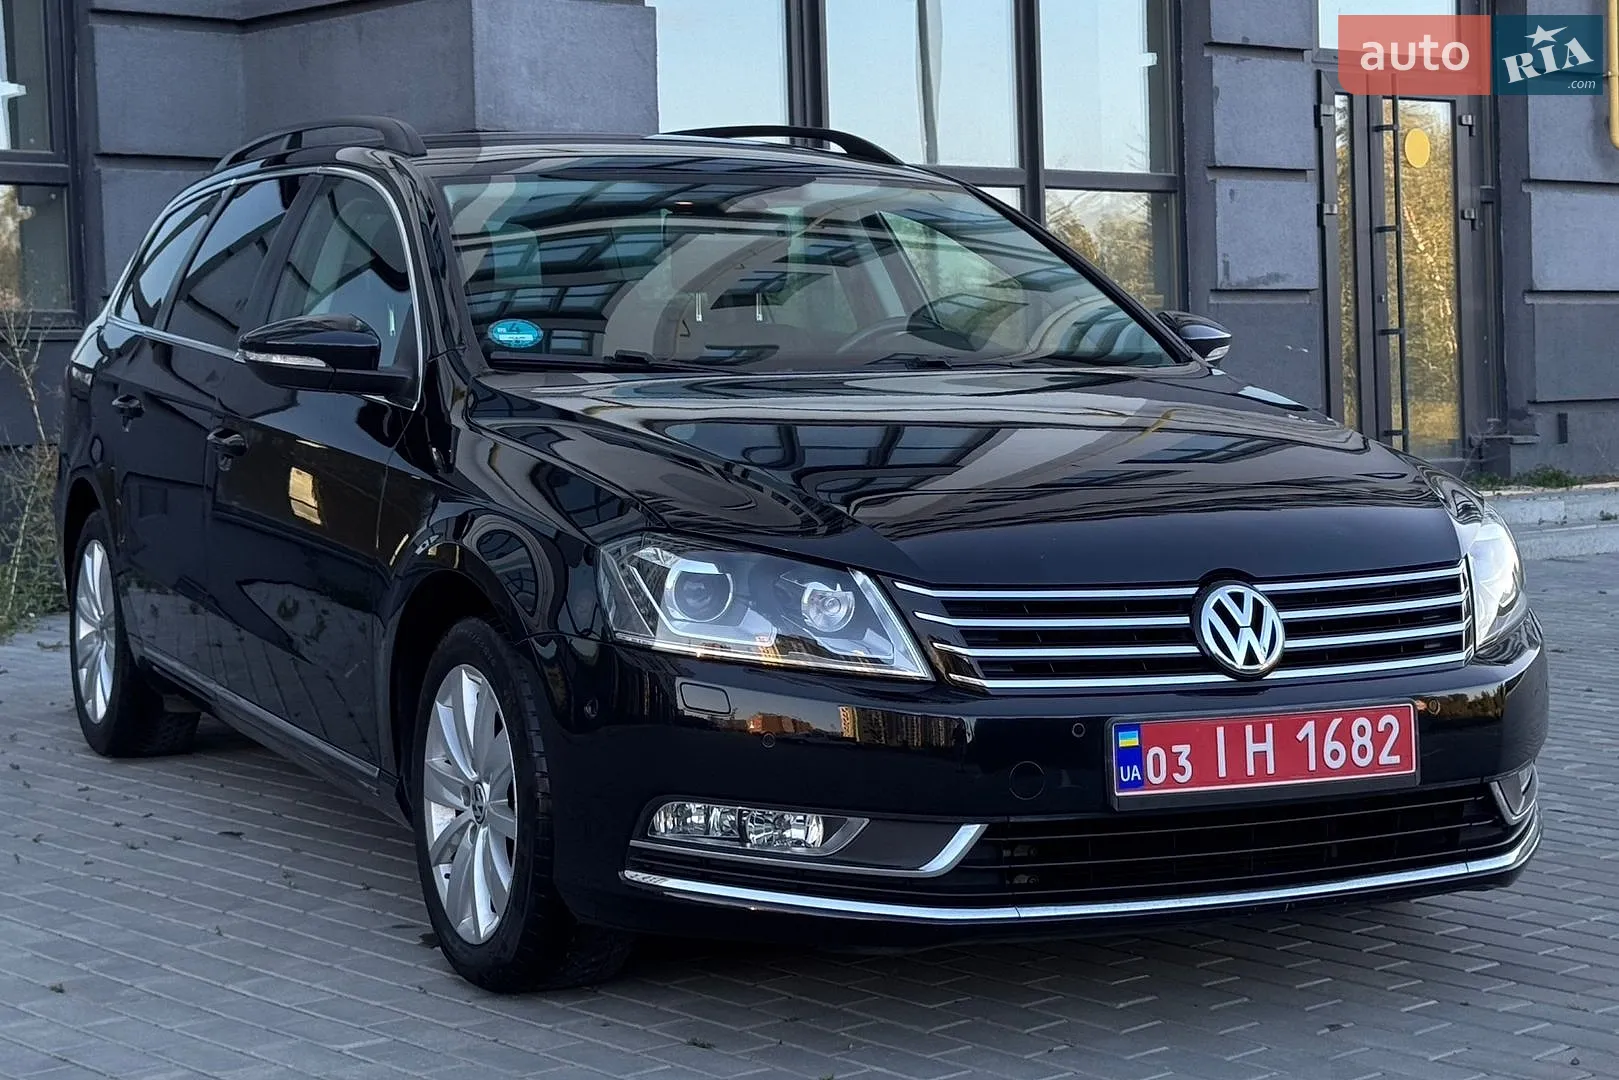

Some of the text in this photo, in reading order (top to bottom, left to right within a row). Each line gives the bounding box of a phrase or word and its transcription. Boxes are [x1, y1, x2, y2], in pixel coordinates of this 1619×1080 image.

[1202, 585, 1284, 669] VW
[1120, 765, 1141, 782] UA
[1146, 744, 1193, 785] 03
[1296, 714, 1401, 771] 1682
